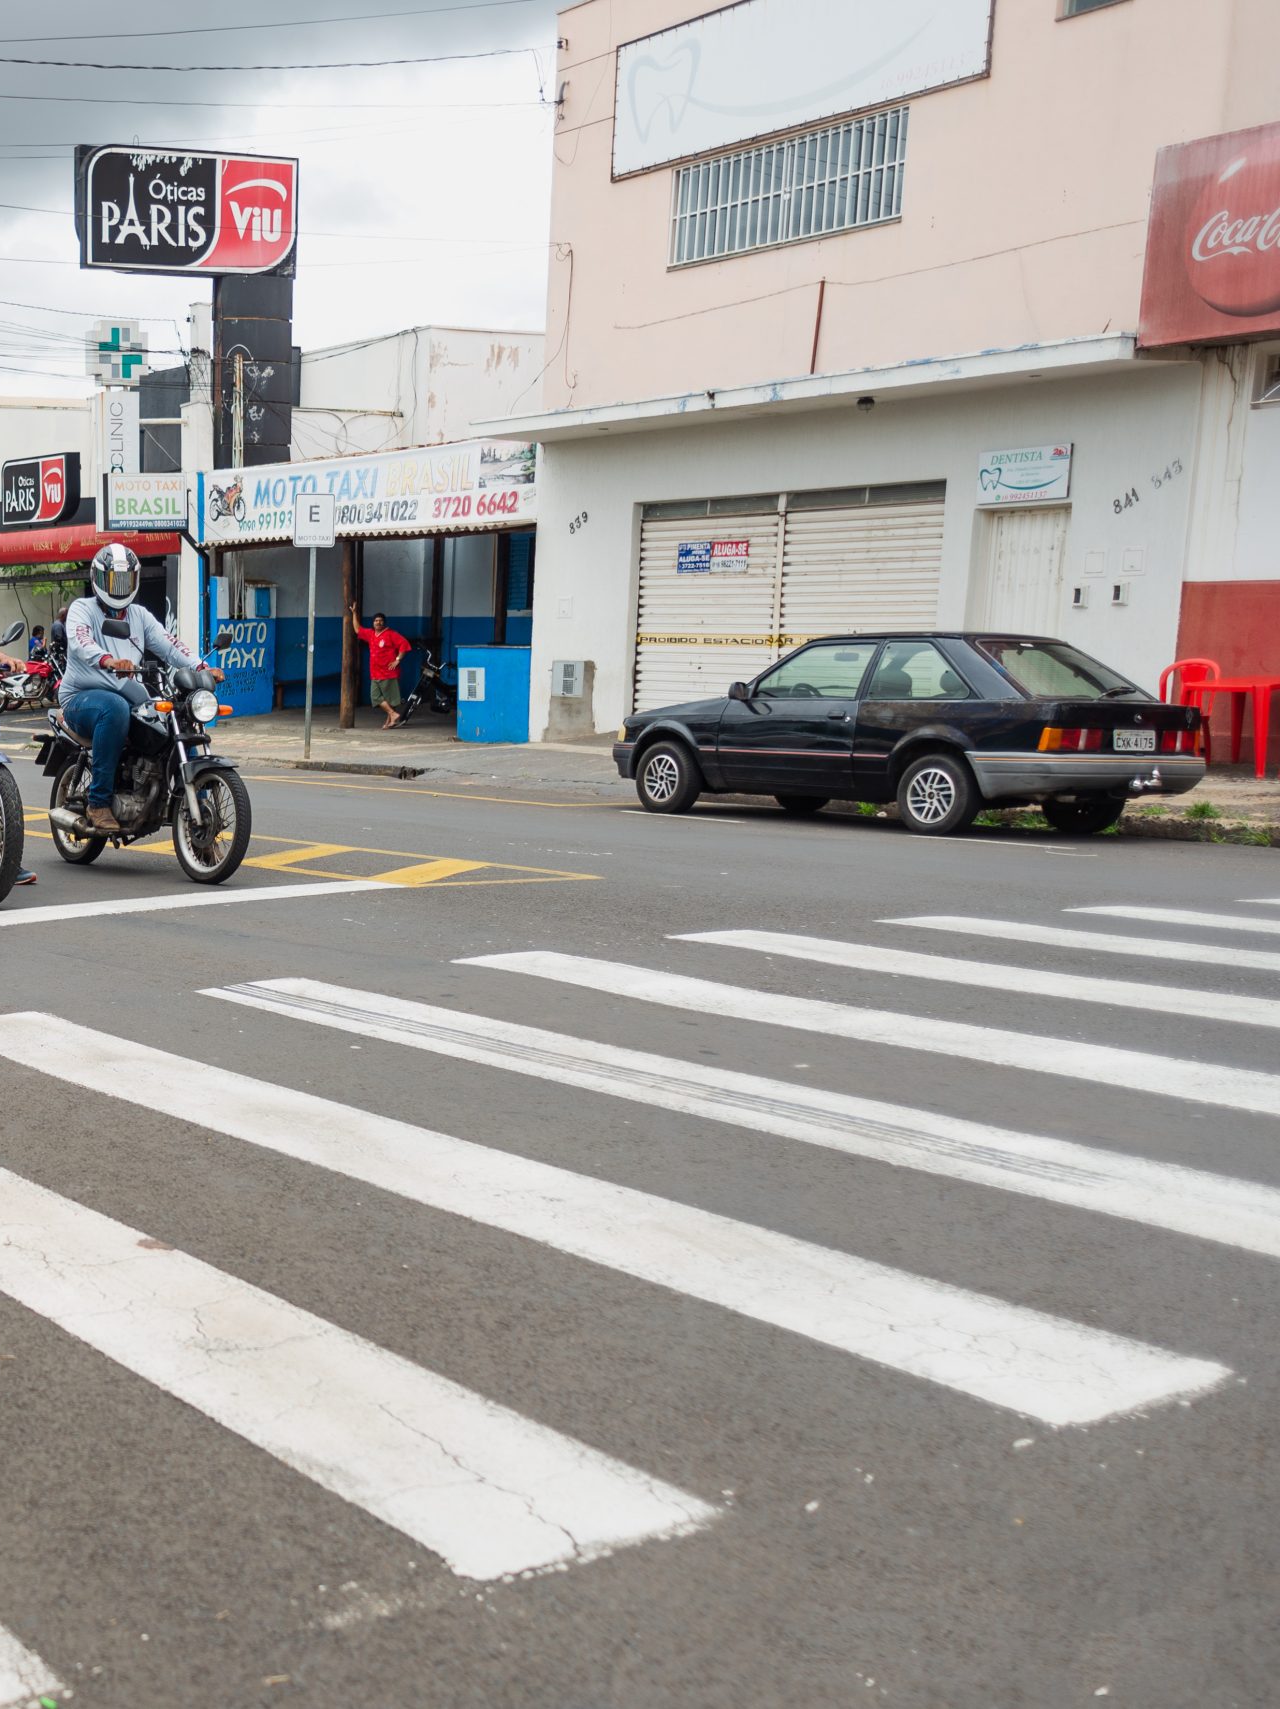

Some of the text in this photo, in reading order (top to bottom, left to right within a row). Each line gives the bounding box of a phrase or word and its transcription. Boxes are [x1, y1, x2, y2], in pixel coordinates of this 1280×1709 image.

[149, 174, 205, 202] Óticas
[101, 177, 207, 248] PARIS
[990, 451, 1043, 465] DENTISTA
[115, 480, 183, 491] MOTO TAXI
[325, 465, 379, 503] TAXI
[385, 453, 474, 497] BRASIL
[5, 477, 36, 513] PARIS
[432, 495, 471, 518] 3720
[477, 491, 520, 515] 6642
[115, 498, 181, 515] BRASIL
[309, 505, 320, 522] E
[569, 511, 588, 534] 839
[713, 543, 747, 556] ALUGA-SE
[218, 622, 267, 643] MOTO
[704, 637, 794, 645] ESTACIONAR
[218, 647, 265, 669] TAXI
